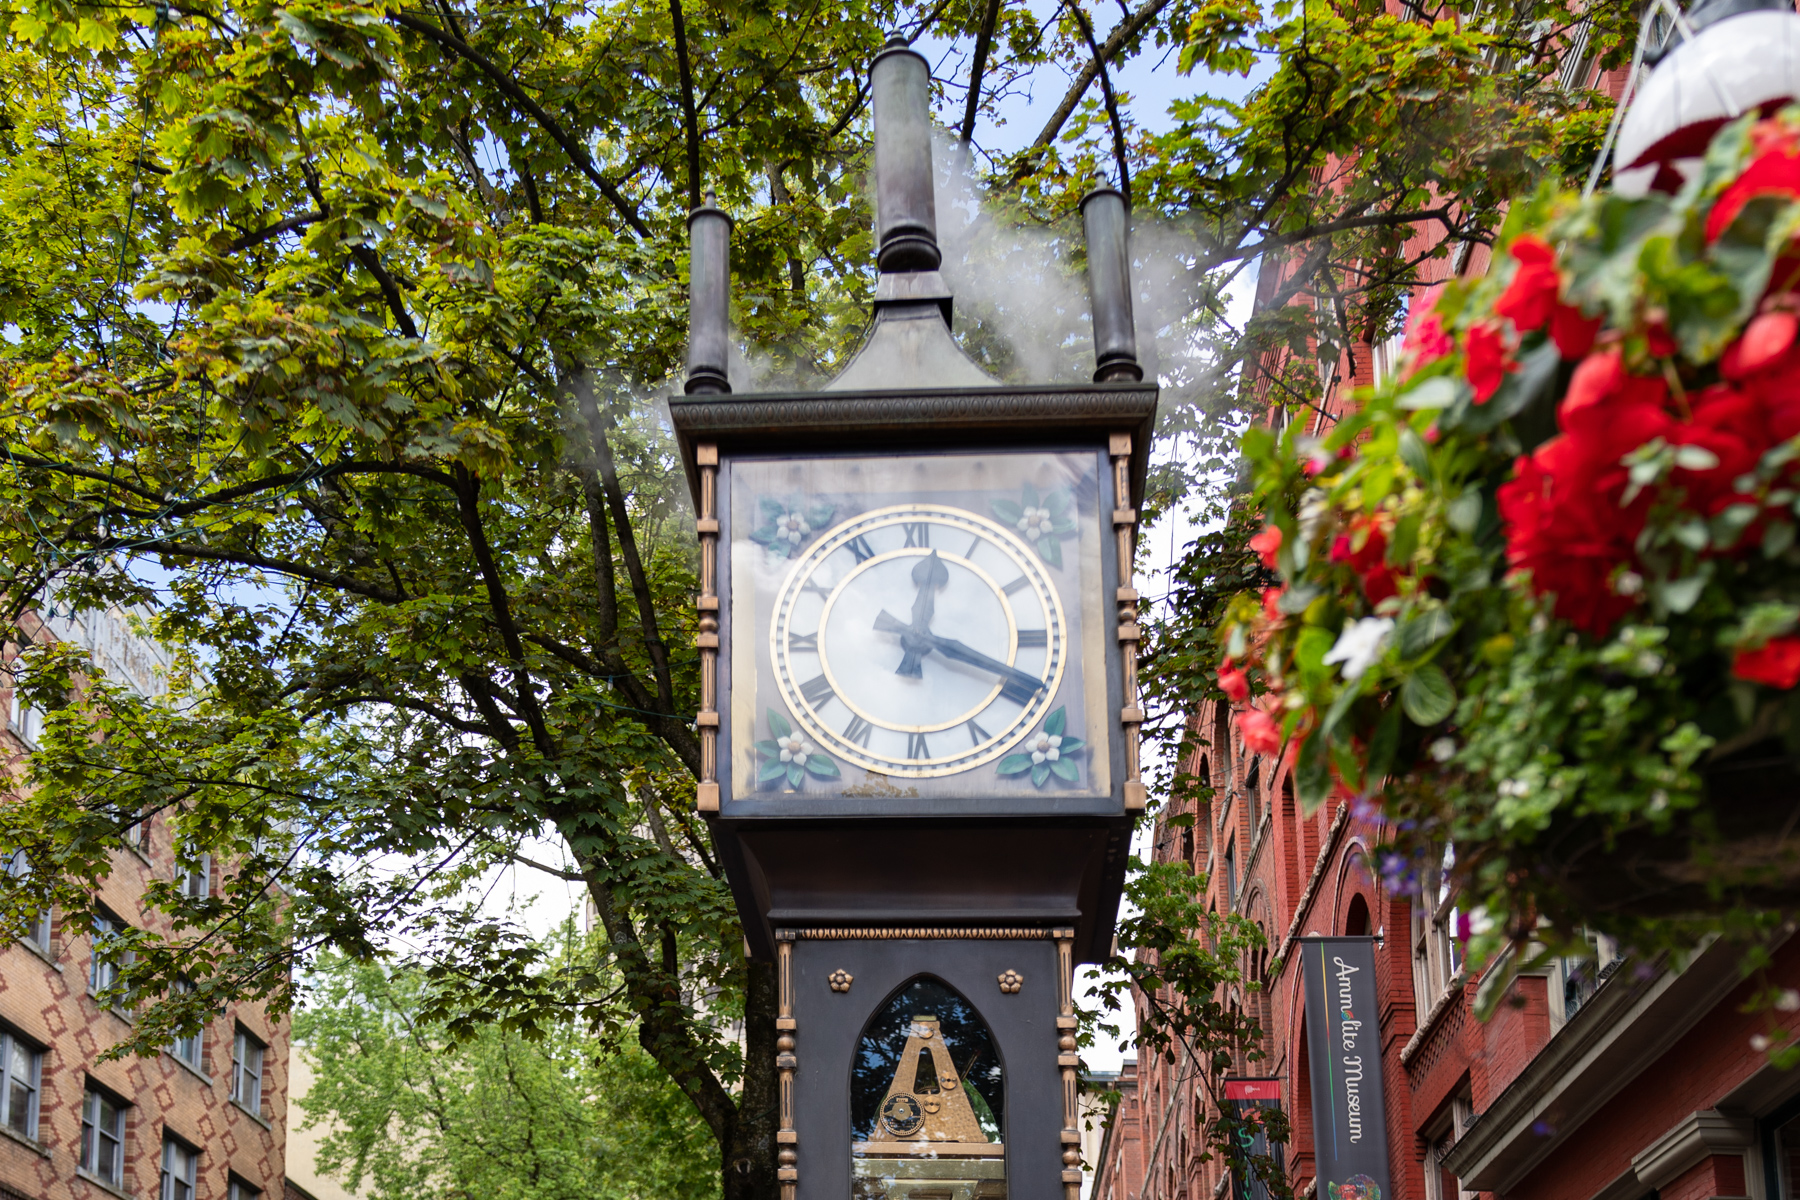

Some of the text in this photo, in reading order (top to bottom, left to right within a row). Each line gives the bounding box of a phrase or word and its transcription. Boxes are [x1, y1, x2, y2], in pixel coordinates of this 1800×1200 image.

[903, 522, 929, 549] XII
[1333, 956, 1363, 1144] Ammolite Museum
